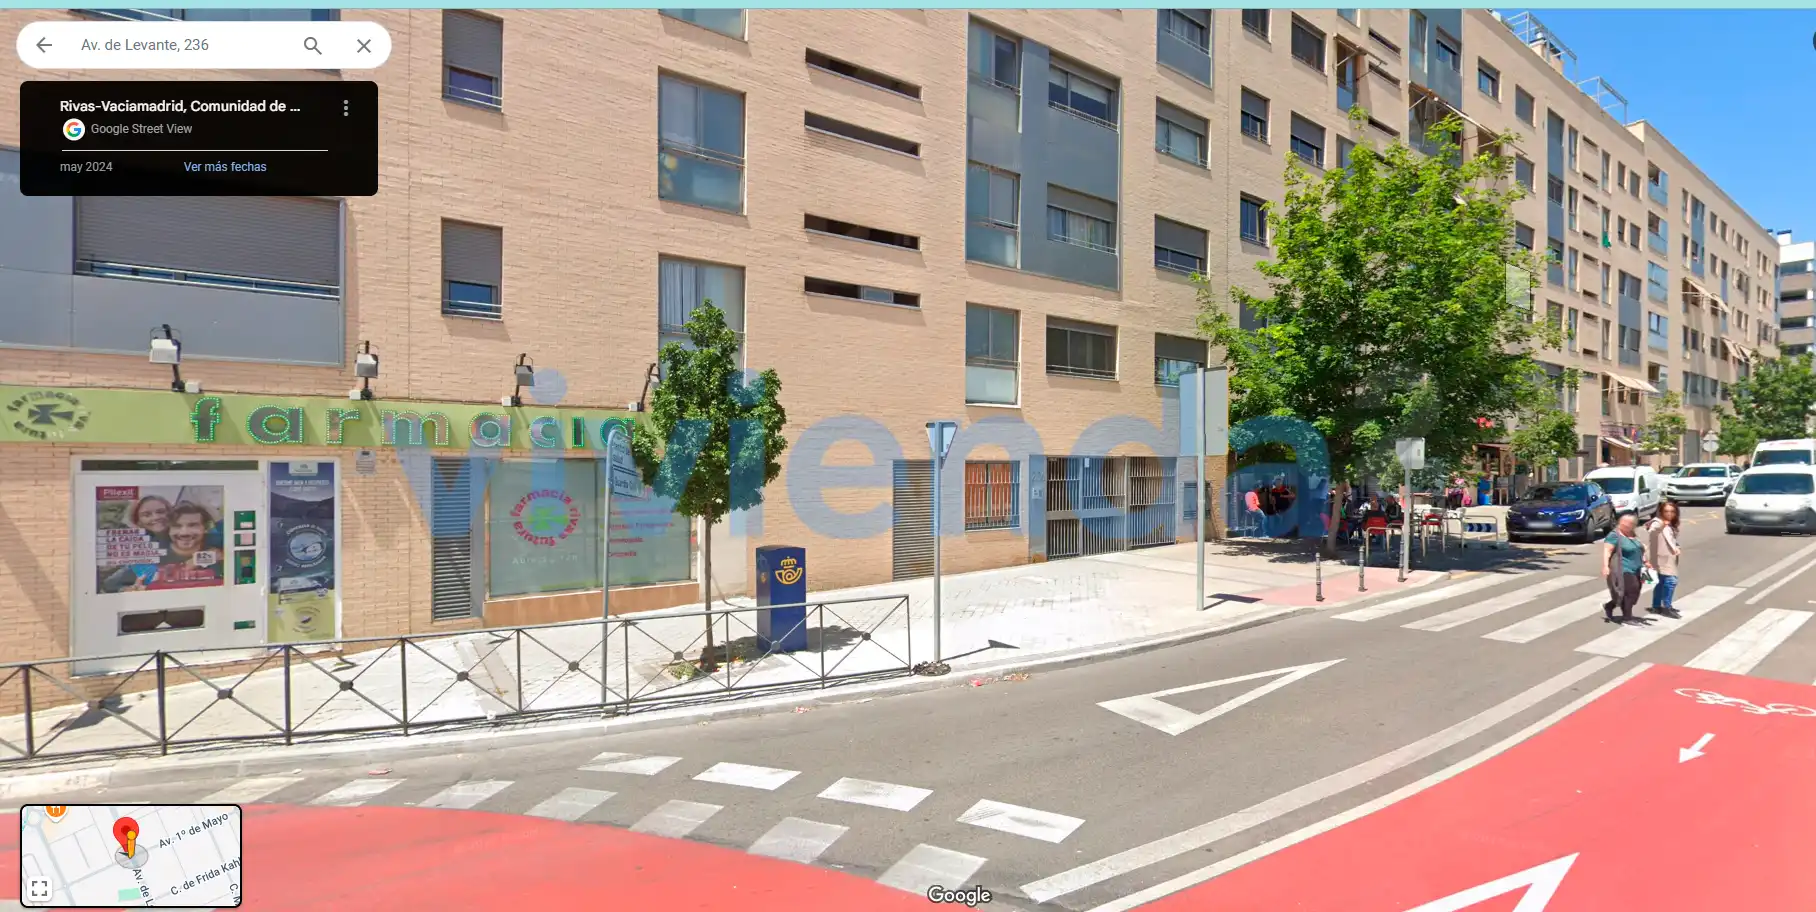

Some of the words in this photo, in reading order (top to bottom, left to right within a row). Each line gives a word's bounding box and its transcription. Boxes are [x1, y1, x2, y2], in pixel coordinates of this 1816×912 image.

[189, 396, 636, 449] farmacia
[510, 490, 573, 517] farmacia
[513, 520, 557, 547] futura
[558, 507, 582, 540] rivas
